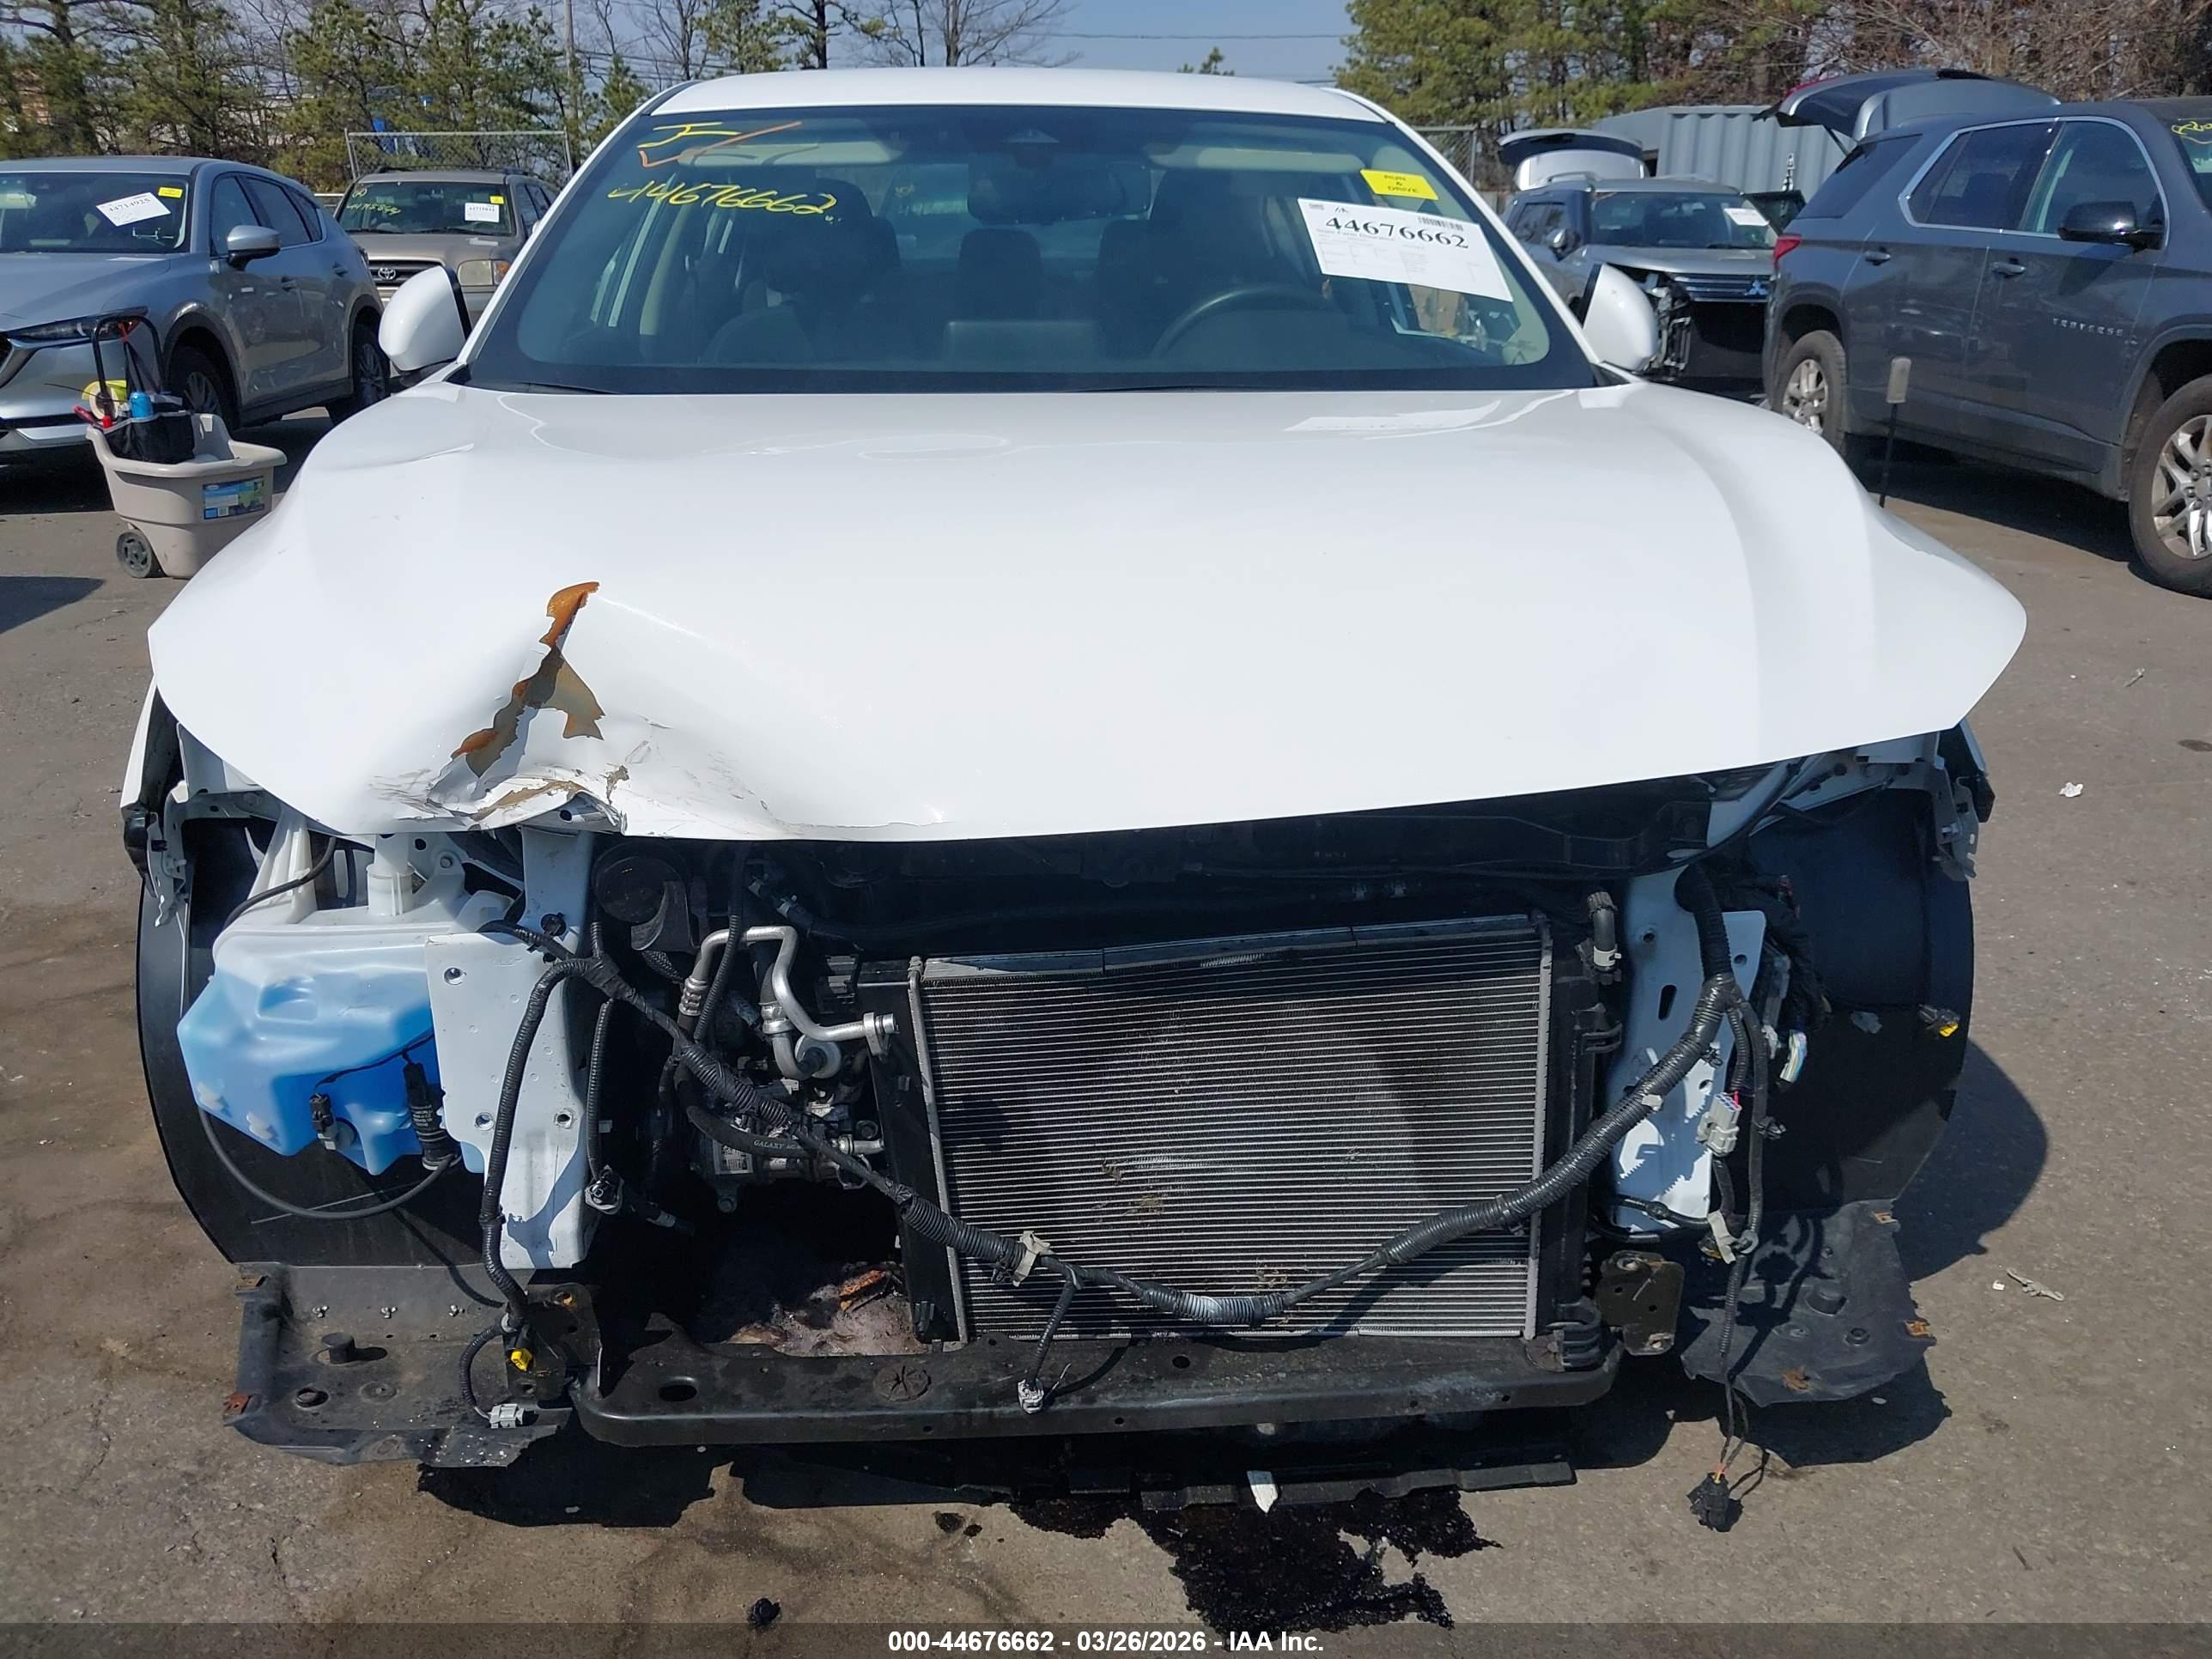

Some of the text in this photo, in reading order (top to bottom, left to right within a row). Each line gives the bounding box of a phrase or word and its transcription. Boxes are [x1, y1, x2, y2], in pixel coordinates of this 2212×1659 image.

[606, 179, 838, 216] 44676662
[1325, 216, 1469, 249] 44676662
[2052, 318, 2124, 337] TRAVERSE
[753, 1139, 784, 1150] GALAXY
